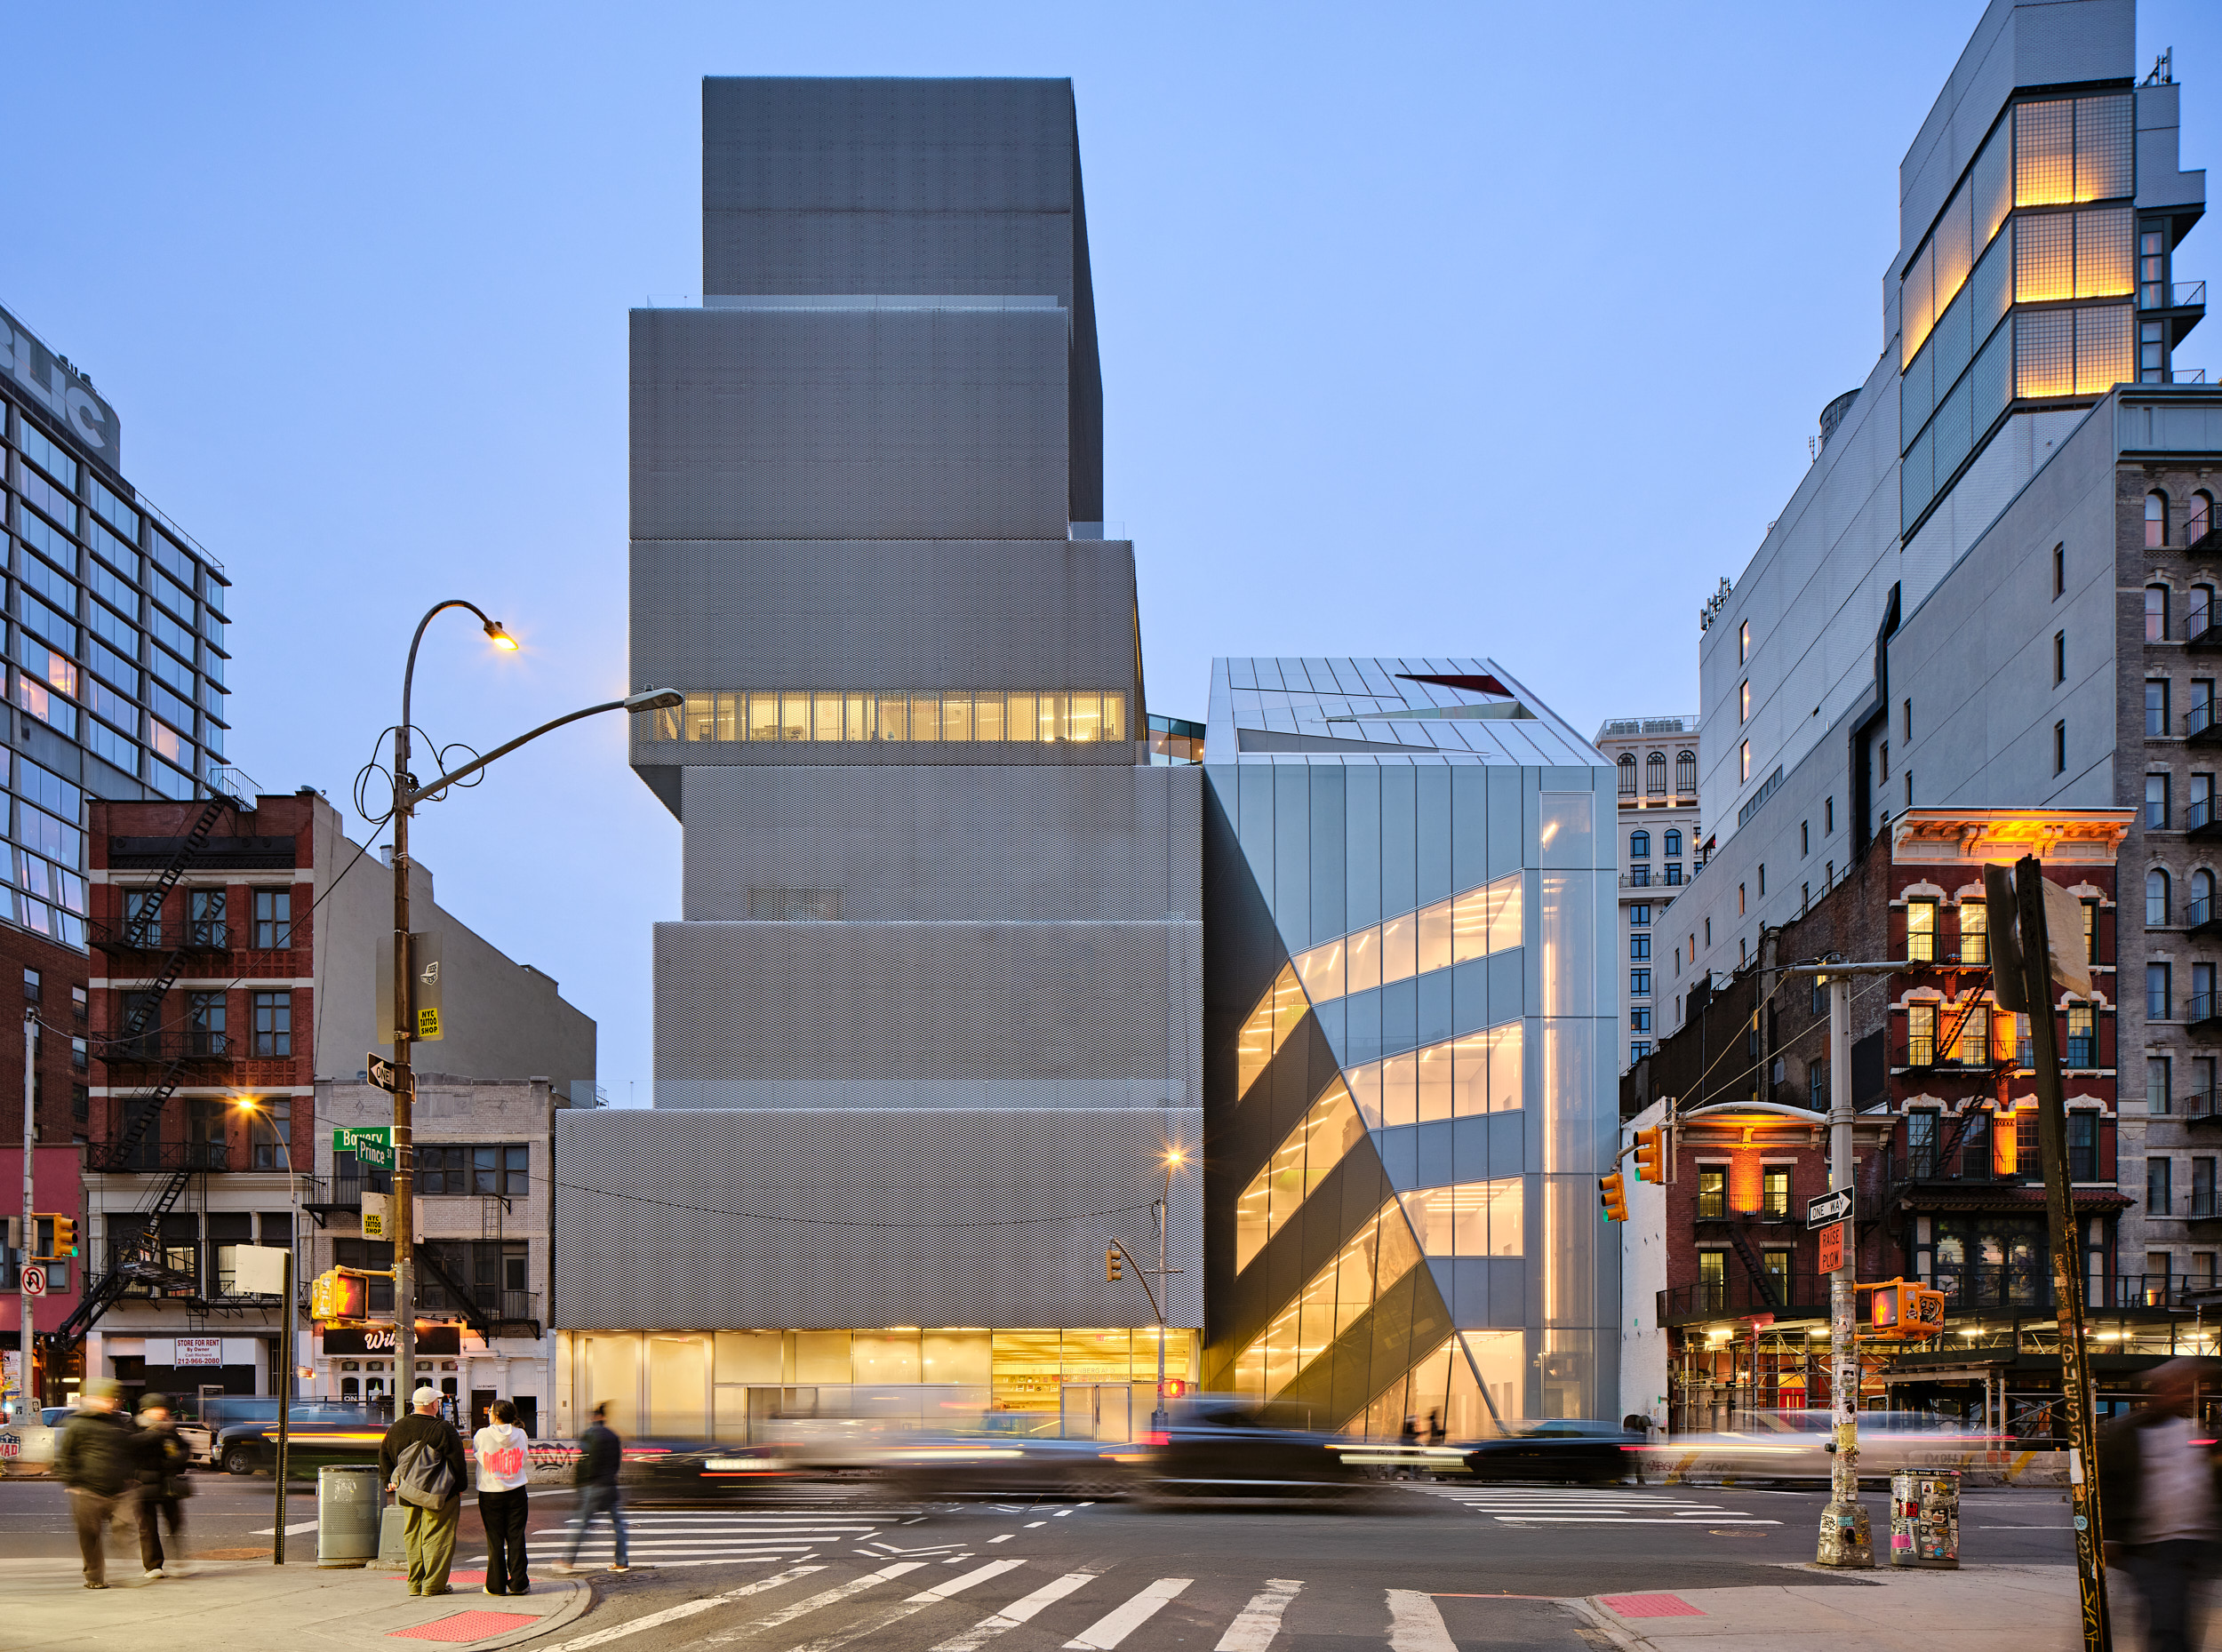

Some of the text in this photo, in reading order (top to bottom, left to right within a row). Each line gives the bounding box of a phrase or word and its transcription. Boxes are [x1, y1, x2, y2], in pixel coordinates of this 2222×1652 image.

[420, 1018, 436, 1026] TATTOO
[376, 1066, 390, 1082] ONE
[360, 1140, 392, 1165] Prince St
[1812, 1198, 1844, 1218] ONE WAY
[1822, 1229, 1840, 1249] RAISE
[1822, 1250, 1840, 1269] PLOW
